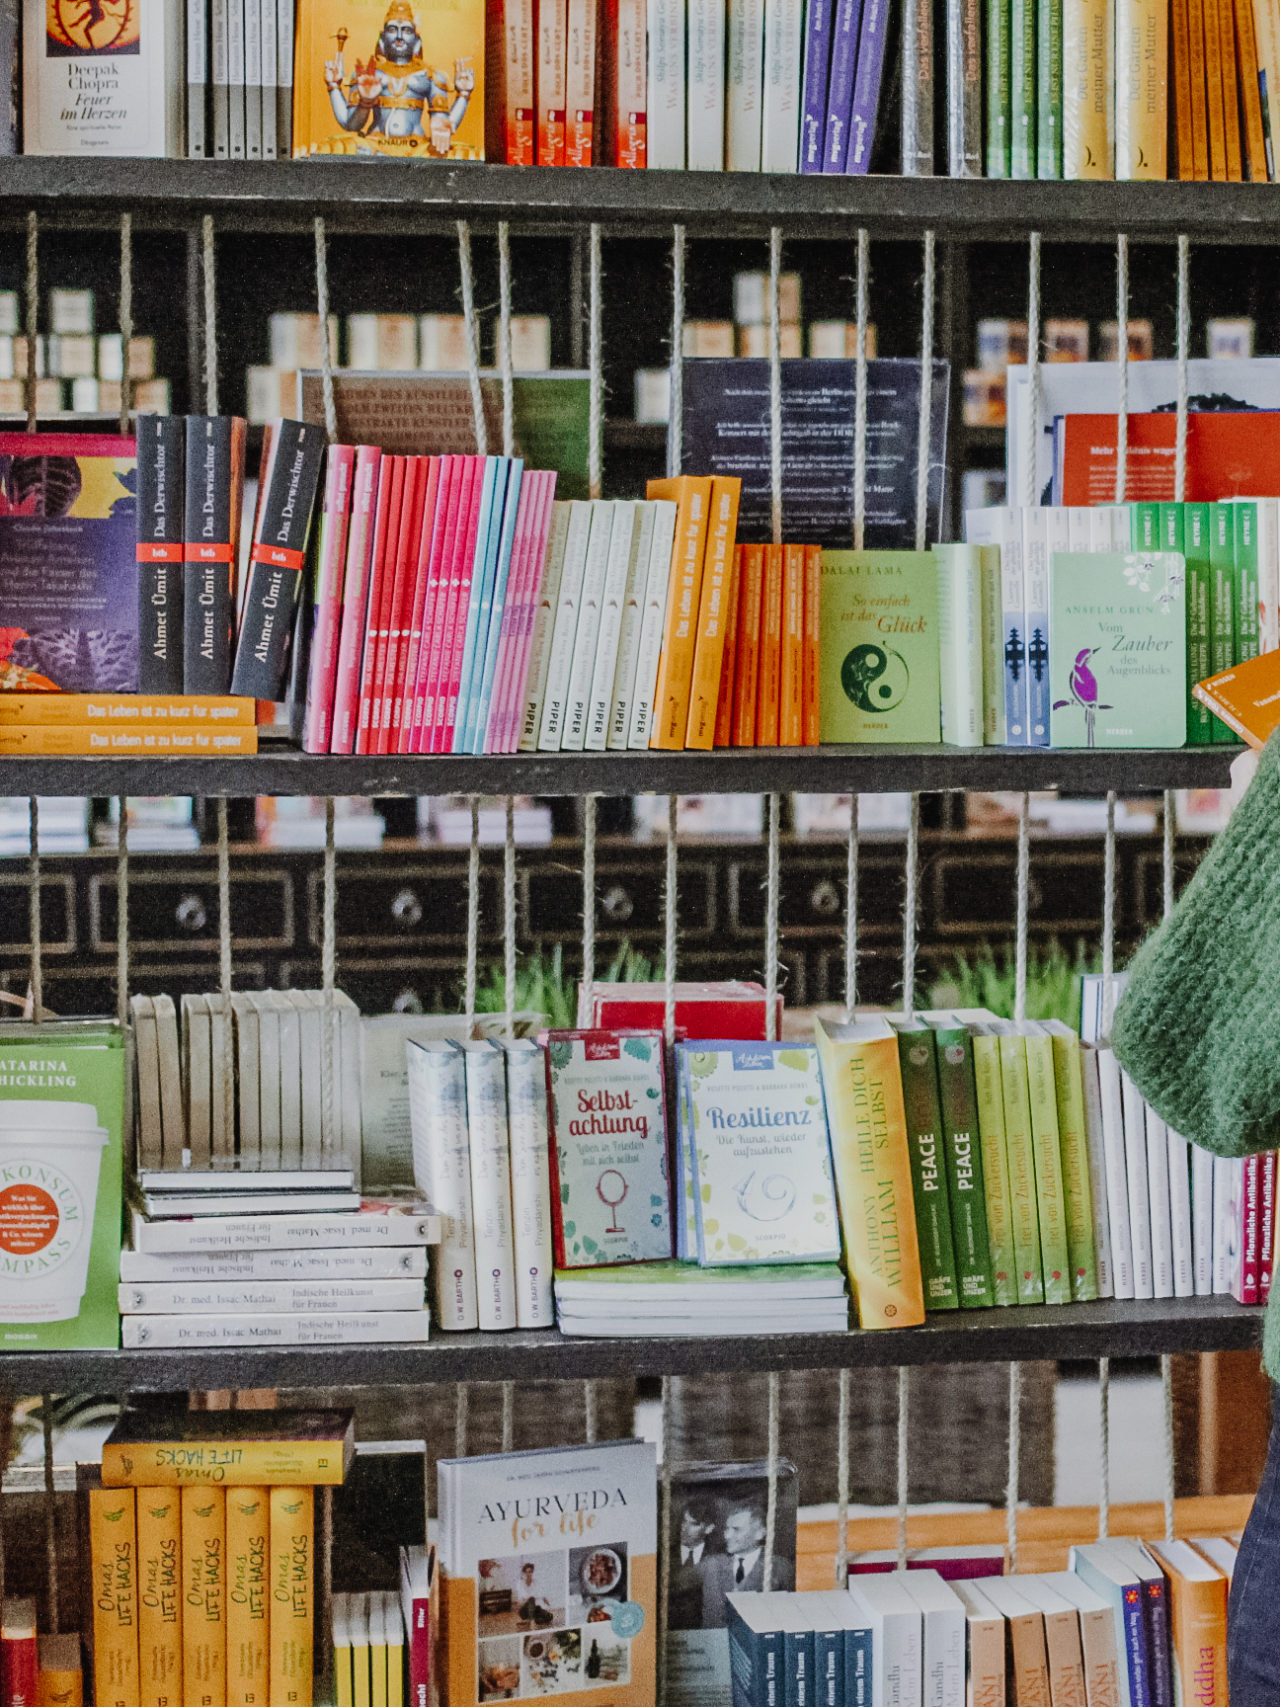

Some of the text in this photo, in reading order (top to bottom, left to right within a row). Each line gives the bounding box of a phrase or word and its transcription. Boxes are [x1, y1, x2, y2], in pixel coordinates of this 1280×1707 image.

[67, 62, 120, 78] Deepak
[1090, 14, 1105, 114] meiner Mutter
[1144, 14, 1158, 114] meiner Mutter
[67, 77, 120, 93] Chopra
[74, 93, 114, 106] Feuer
[60, 107, 127, 121] im Herzen
[154, 444, 166, 537] Das Derwischtor
[203, 444, 216, 537] Das Derwischtor
[278, 450, 304, 542] Das Derwischtor
[151, 568, 167, 659] Ahmet Ümit
[199, 568, 214, 659] Ahmet Ümit
[254, 572, 283, 662] Ahmet Ümit
[869, 593, 911, 608] einfach
[1065, 605, 1114, 615] ANSELM
[857, 608, 876, 622] das
[877, 615, 928, 634] Glück
[1098, 621, 1123, 634] Vom
[1112, 634, 1174, 652] Zauber
[1107, 665, 1171, 678] Augenblicks
[1119, 655, 1137, 665] des
[88, 704, 107, 718] Das
[109, 704, 140, 718] Leben
[155, 706, 167, 718] zu
[524, 702, 536, 734] PIPER
[548, 701, 559, 733] PIPER
[571, 702, 583, 733] PIPER
[594, 701, 605, 733] PIPER
[614, 701, 625, 732] PIPER
[636, 702, 648, 733] PIPER
[0, 1060, 68, 1072] ATARINA
[0, 1074, 77, 1087] HICKLING
[577, 1088, 639, 1113] Selbst-
[706, 1105, 812, 1129] Resilienz
[568, 1113, 649, 1139] achtung
[716, 1132, 806, 1145] Die wieder
[732, 1145, 793, 1159] aufzustehen
[849, 1057, 883, 1276] ANTHONY HEILE DICH
[918, 1133, 939, 1191] PEACE
[954, 1132, 974, 1190] PEACE
[1012, 1133, 1030, 1200] Zuckersucht
[1039, 1133, 1057, 1199] Zuckersucht
[868, 1079, 902, 1288] WILLIAM SELBST
[1245, 1158, 1257, 1263] Pflanzliche Antibiotika
[1262, 1157, 1274, 1261] Pflanzliche Antibiotika
[190, 1293, 240, 1304] med. Issac
[178, 1327, 245, 1338] Dr. med. Issac
[156, 1448, 243, 1467] LIFE HACKS
[174, 1467, 226, 1483] Omas
[478, 1487, 628, 1524] AYURVEDA
[510, 1508, 597, 1548] for life
[160, 1538, 176, 1586] HACKS
[97, 1562, 115, 1612] Omas
[115, 1541, 133, 1626] LIFE HACKS
[142, 1559, 159, 1607] Omas
[186, 1556, 204, 1606] Omas
[204, 1537, 221, 1622] LIFE HACKS
[161, 1589, 177, 1623] LIFE
[766, 1652, 776, 1707] einem Traum
[796, 1651, 806, 1707] einem Traum
[826, 1650, 836, 1706] einem Traum
[855, 1649, 865, 1704] einem Traum
